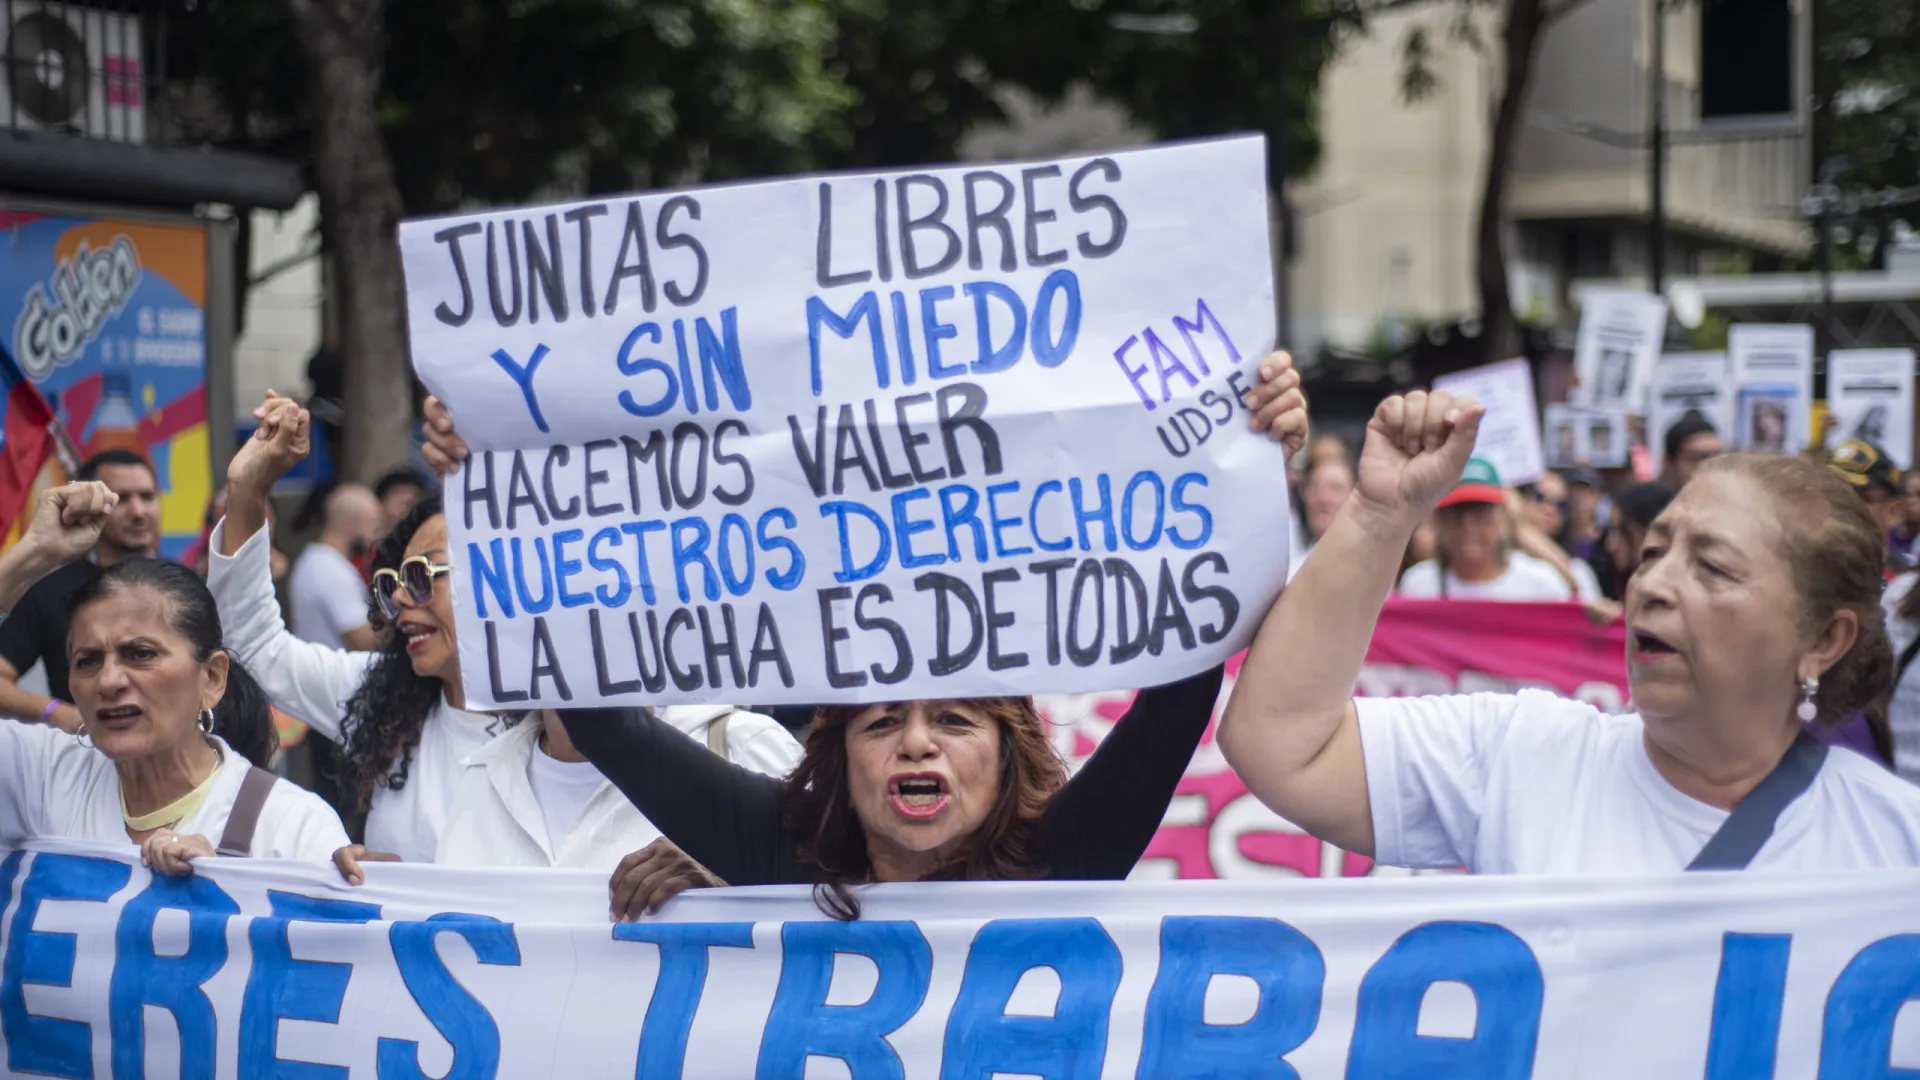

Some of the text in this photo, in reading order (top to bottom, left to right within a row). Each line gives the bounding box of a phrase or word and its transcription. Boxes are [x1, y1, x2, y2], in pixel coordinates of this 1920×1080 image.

[434, 157, 1128, 327] JUNTAS LIBRES
[489, 269, 1083, 434] Y SIN MIEDO
[1113, 298, 1242, 411] FAM
[1156, 370, 1253, 458] UDSE
[463, 382, 1003, 530] HACEMOS VALER
[467, 470, 1213, 619] NUESTROS DERECHOS
[485, 616, 573, 703] LA
[588, 601, 795, 697] LUCHA
[817, 583, 914, 689] ES
[0, 850, 522, 1080] ERES
